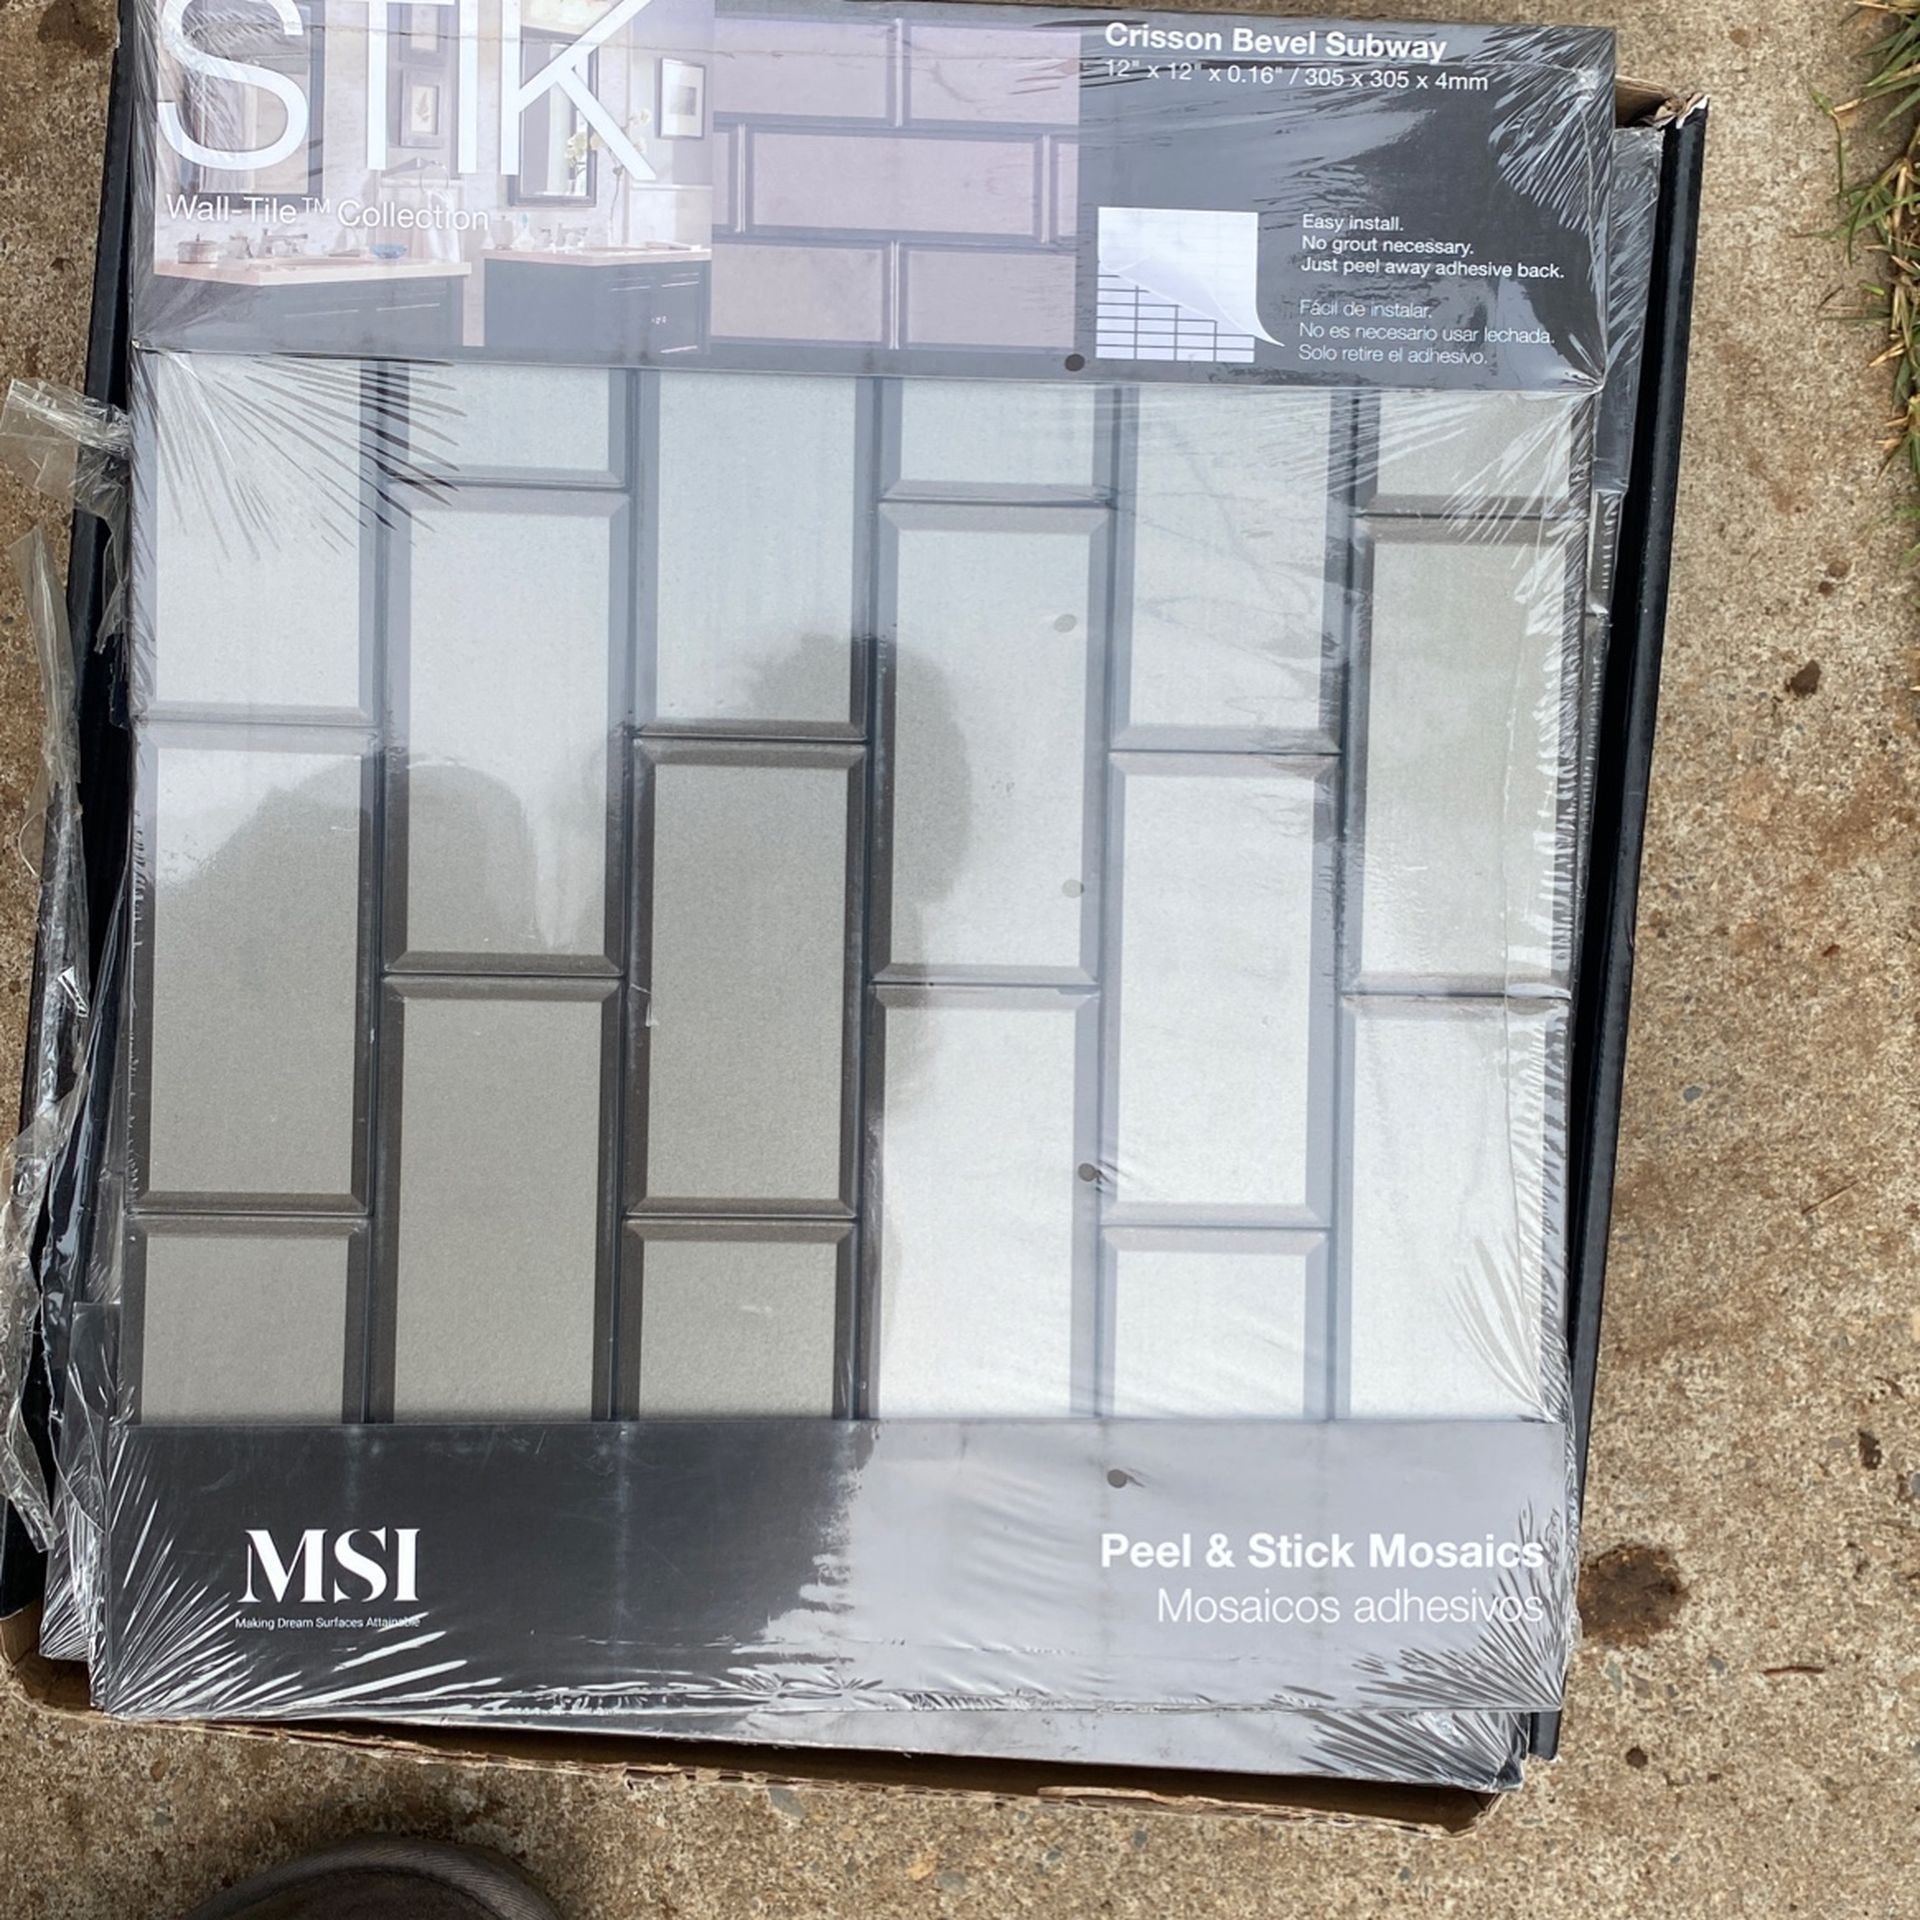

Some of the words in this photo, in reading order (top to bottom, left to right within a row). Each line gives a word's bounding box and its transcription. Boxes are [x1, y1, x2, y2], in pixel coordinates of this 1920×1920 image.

[1105, 23, 1222, 51] Crisson
[1233, 27, 1316, 55] Bevel
[1325, 32, 1446, 63] Subway
[1106, 60, 1139, 78] 12"
[1147, 68, 1159, 80] x
[1209, 70, 1220, 82] x
[1228, 65, 1284, 85] 0.16"
[1289, 68, 1298, 85] /
[1305, 68, 1344, 87] 305
[1350, 74, 1363, 87] x
[1370, 70, 1409, 89] 305
[1416, 75, 1428, 88] x
[1434, 72, 1488, 91] 4mm
[337, 200, 489, 231] Collection
[1303, 214, 1344, 233] Easy
[1349, 215, 1403, 232] install.
[1302, 237, 1326, 251] No
[1332, 238, 1378, 256] grout
[1383, 240, 1474, 258] necessary.
[1302, 258, 1338, 273] Just
[1344, 259, 1380, 278] peel
[1385, 263, 1430, 279] away
[1436, 261, 1512, 277] adhesive
[1518, 263, 1564, 279] back.
[1300, 299, 1338, 316] Fácil
[1344, 302, 1365, 317] de
[1370, 302, 1432, 319] instalar.
[1300, 323, 1324, 338] No
[1329, 327, 1349, 339] es
[1355, 326, 1437, 341] necesario
[1443, 329, 1479, 343] usar
[1484, 327, 1554, 345] lechada.
[1299, 345, 1337, 361] Solo
[1342, 346, 1383, 362] retire
[1389, 347, 1403, 363] el
[1409, 348, 1487, 364] adhesivo.
[1101, 1533, 1191, 1567] Peel
[1205, 1533, 1235, 1569] &
[1248, 1533, 1355, 1568] Stick
[1369, 1533, 1543, 1569] Mosaics
[239, 1528, 421, 1603] MSI
[1158, 1588, 1340, 1623] Mosaicos
[1355, 1588, 1543, 1623] adhesivos
[236, 1617, 275, 1631] Making
[278, 1617, 313, 1628] Dream
[316, 1617, 364, 1628] Surfaces
